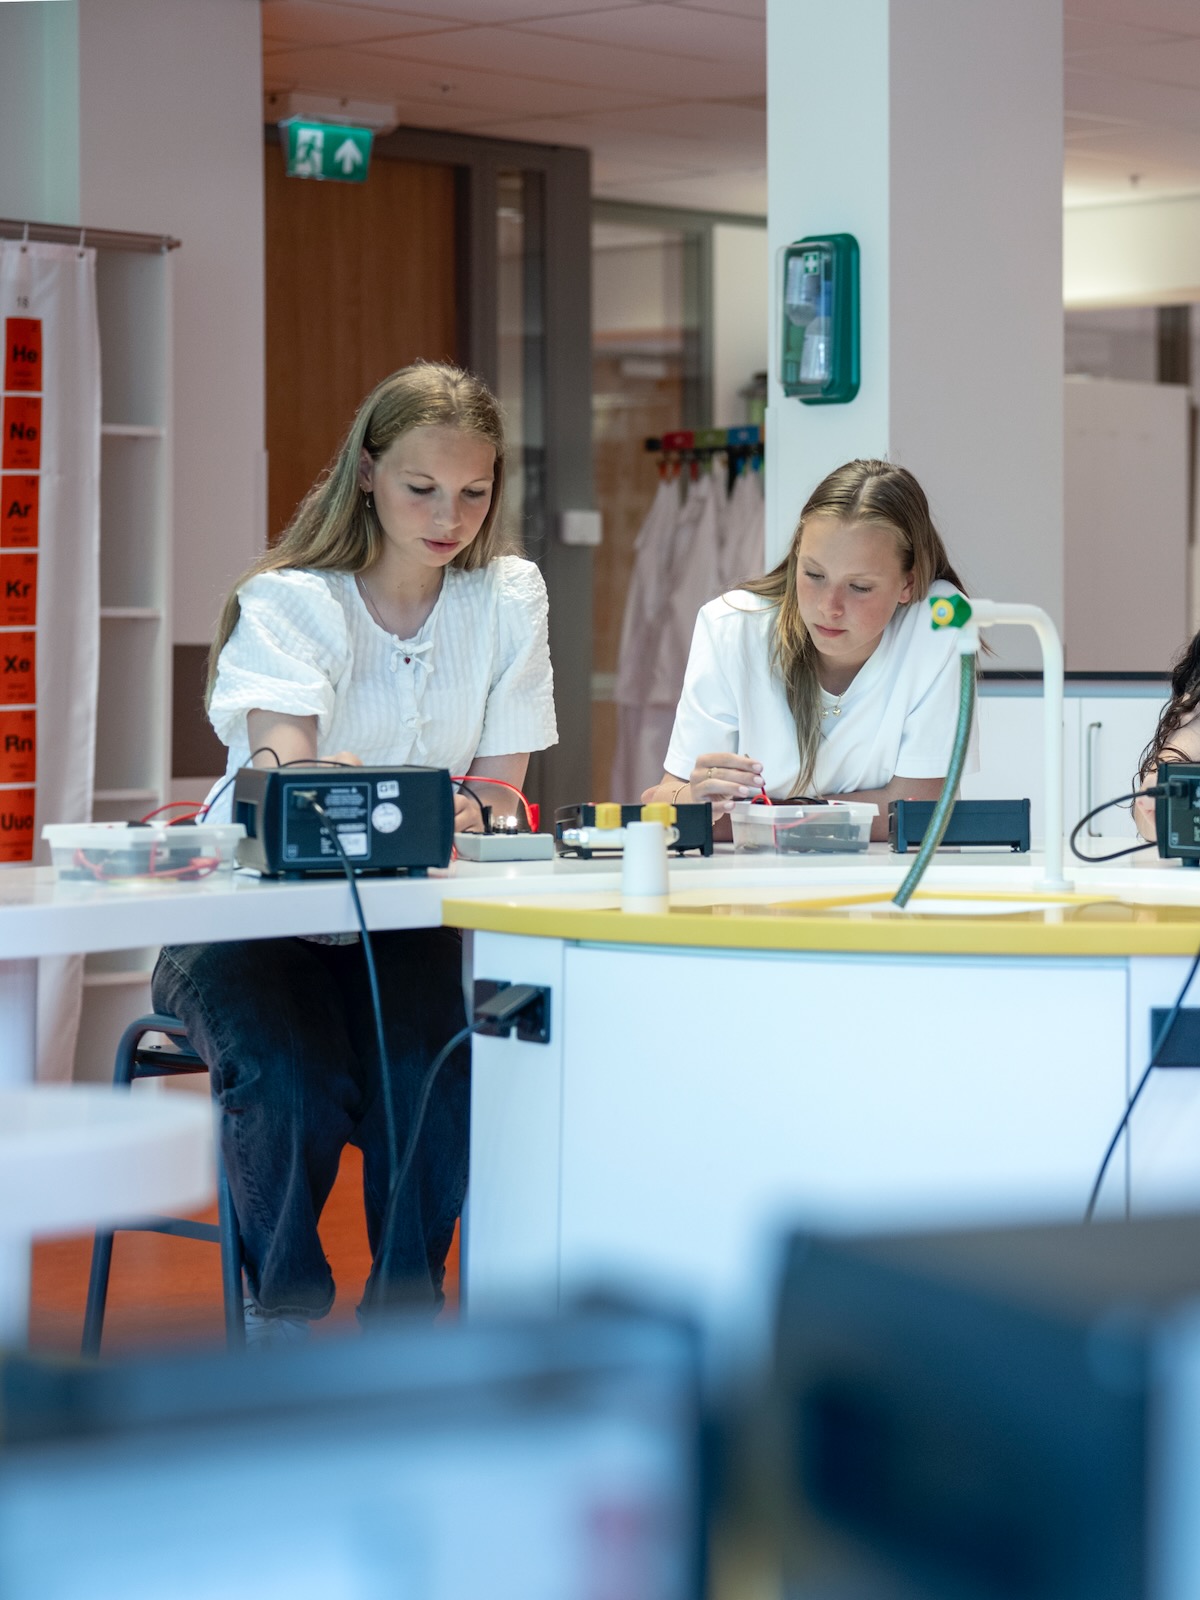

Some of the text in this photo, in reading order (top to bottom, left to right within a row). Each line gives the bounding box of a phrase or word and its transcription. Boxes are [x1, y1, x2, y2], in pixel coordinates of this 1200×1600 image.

[12, 344, 38, 363] He
[10, 422, 37, 441] Ne
[7, 501, 32, 518] Ar
[6, 580, 31, 598] Kr
[4, 656, 31, 673] Xe
[5, 735, 33, 752] Rn
[1, 813, 34, 831] Uuo
